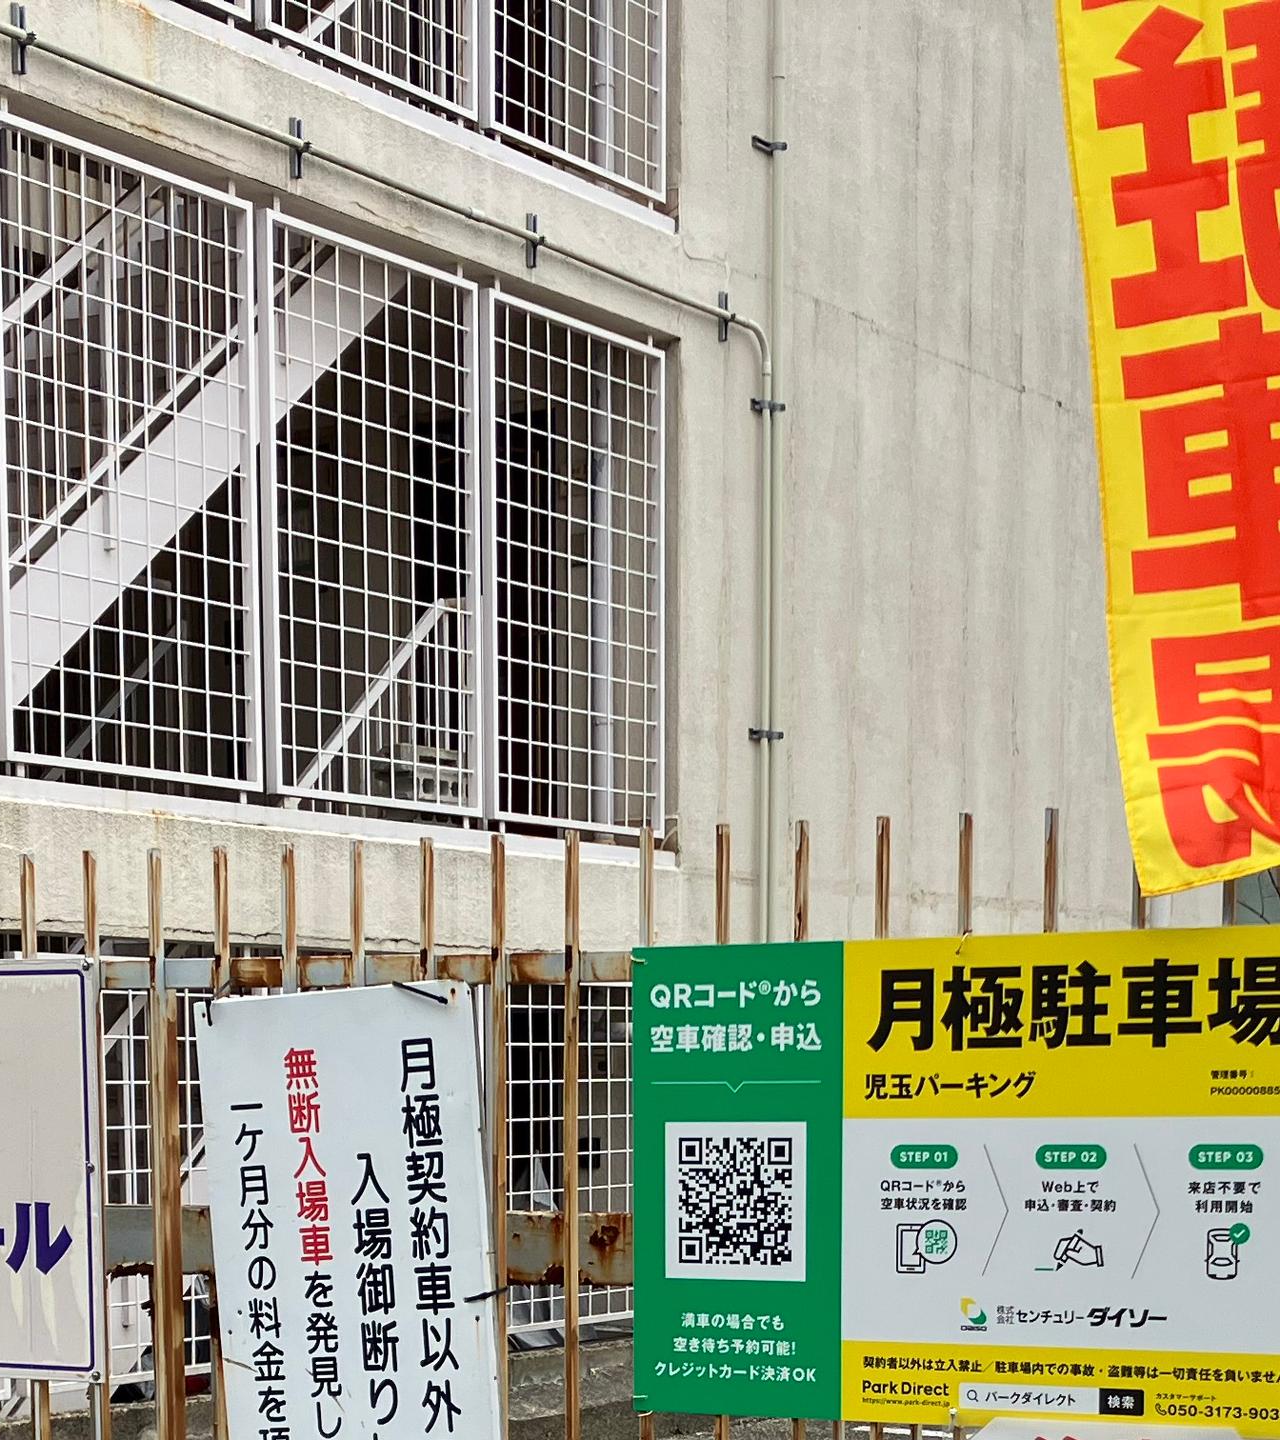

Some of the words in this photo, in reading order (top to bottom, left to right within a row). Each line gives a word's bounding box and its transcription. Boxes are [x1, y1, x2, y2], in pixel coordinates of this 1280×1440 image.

[650, 1021, 823, 1054] 空車確認・申込
[864, 1070, 1037, 1100] 児玉パーキング
[899, 1151, 930, 1163] STEP
[933, 1151, 949, 1163] 01
[1044, 1151, 1075, 1163] STEP
[1080, 1151, 1098, 1163] 02
[1197, 1151, 1232, 1163] STEP
[1236, 1151, 1255, 1164] 03
[1041, 1180, 1100, 1194] Web上で
[1187, 1180, 1262, 1195] 来店不要で
[880, 1197, 968, 1211] 空車状況を確認
[1024, 1198, 1117, 1213] 申込・審査・契約
[1195, 1199, 1254, 1214] 利用開始
[681, 1312, 785, 1331] 満車の場合でも
[862, 1379, 899, 1395] Park
[901, 1381, 950, 1397] Direct
[1107, 1394, 1136, 1410] 検索
